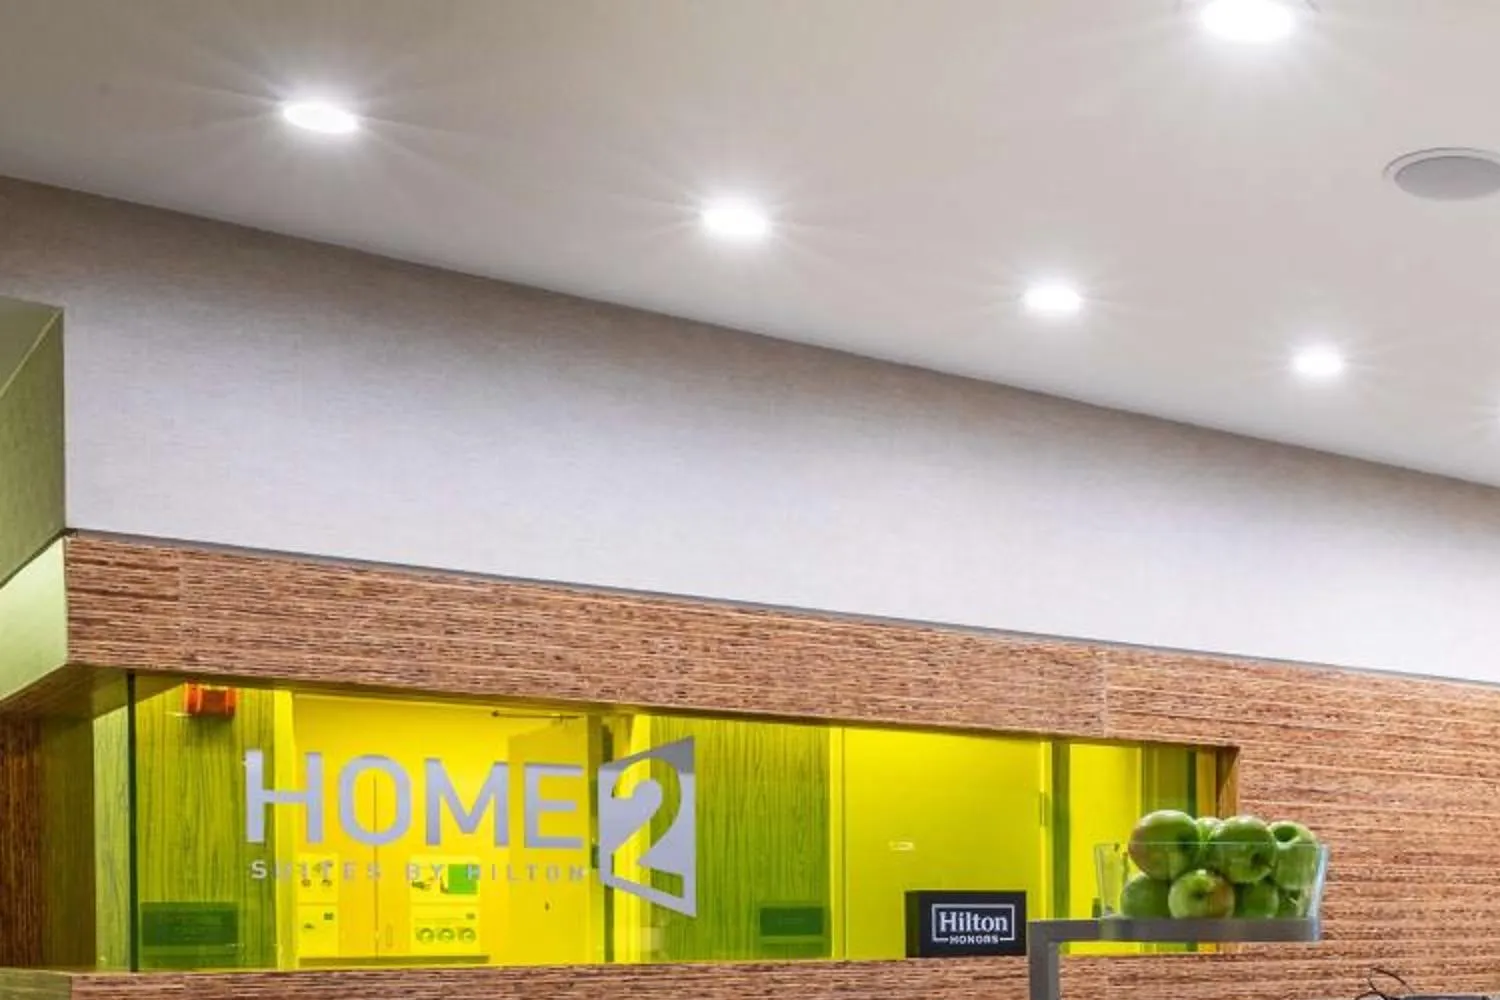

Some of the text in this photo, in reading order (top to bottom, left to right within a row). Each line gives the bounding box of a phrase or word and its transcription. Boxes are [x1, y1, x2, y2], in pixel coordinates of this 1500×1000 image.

[244, 749, 585, 849] HOME
[251, 859, 586, 882] SUITES BY HILTON
[939, 911, 1008, 933] Hilton
[949, 934, 999, 945] HONORS
